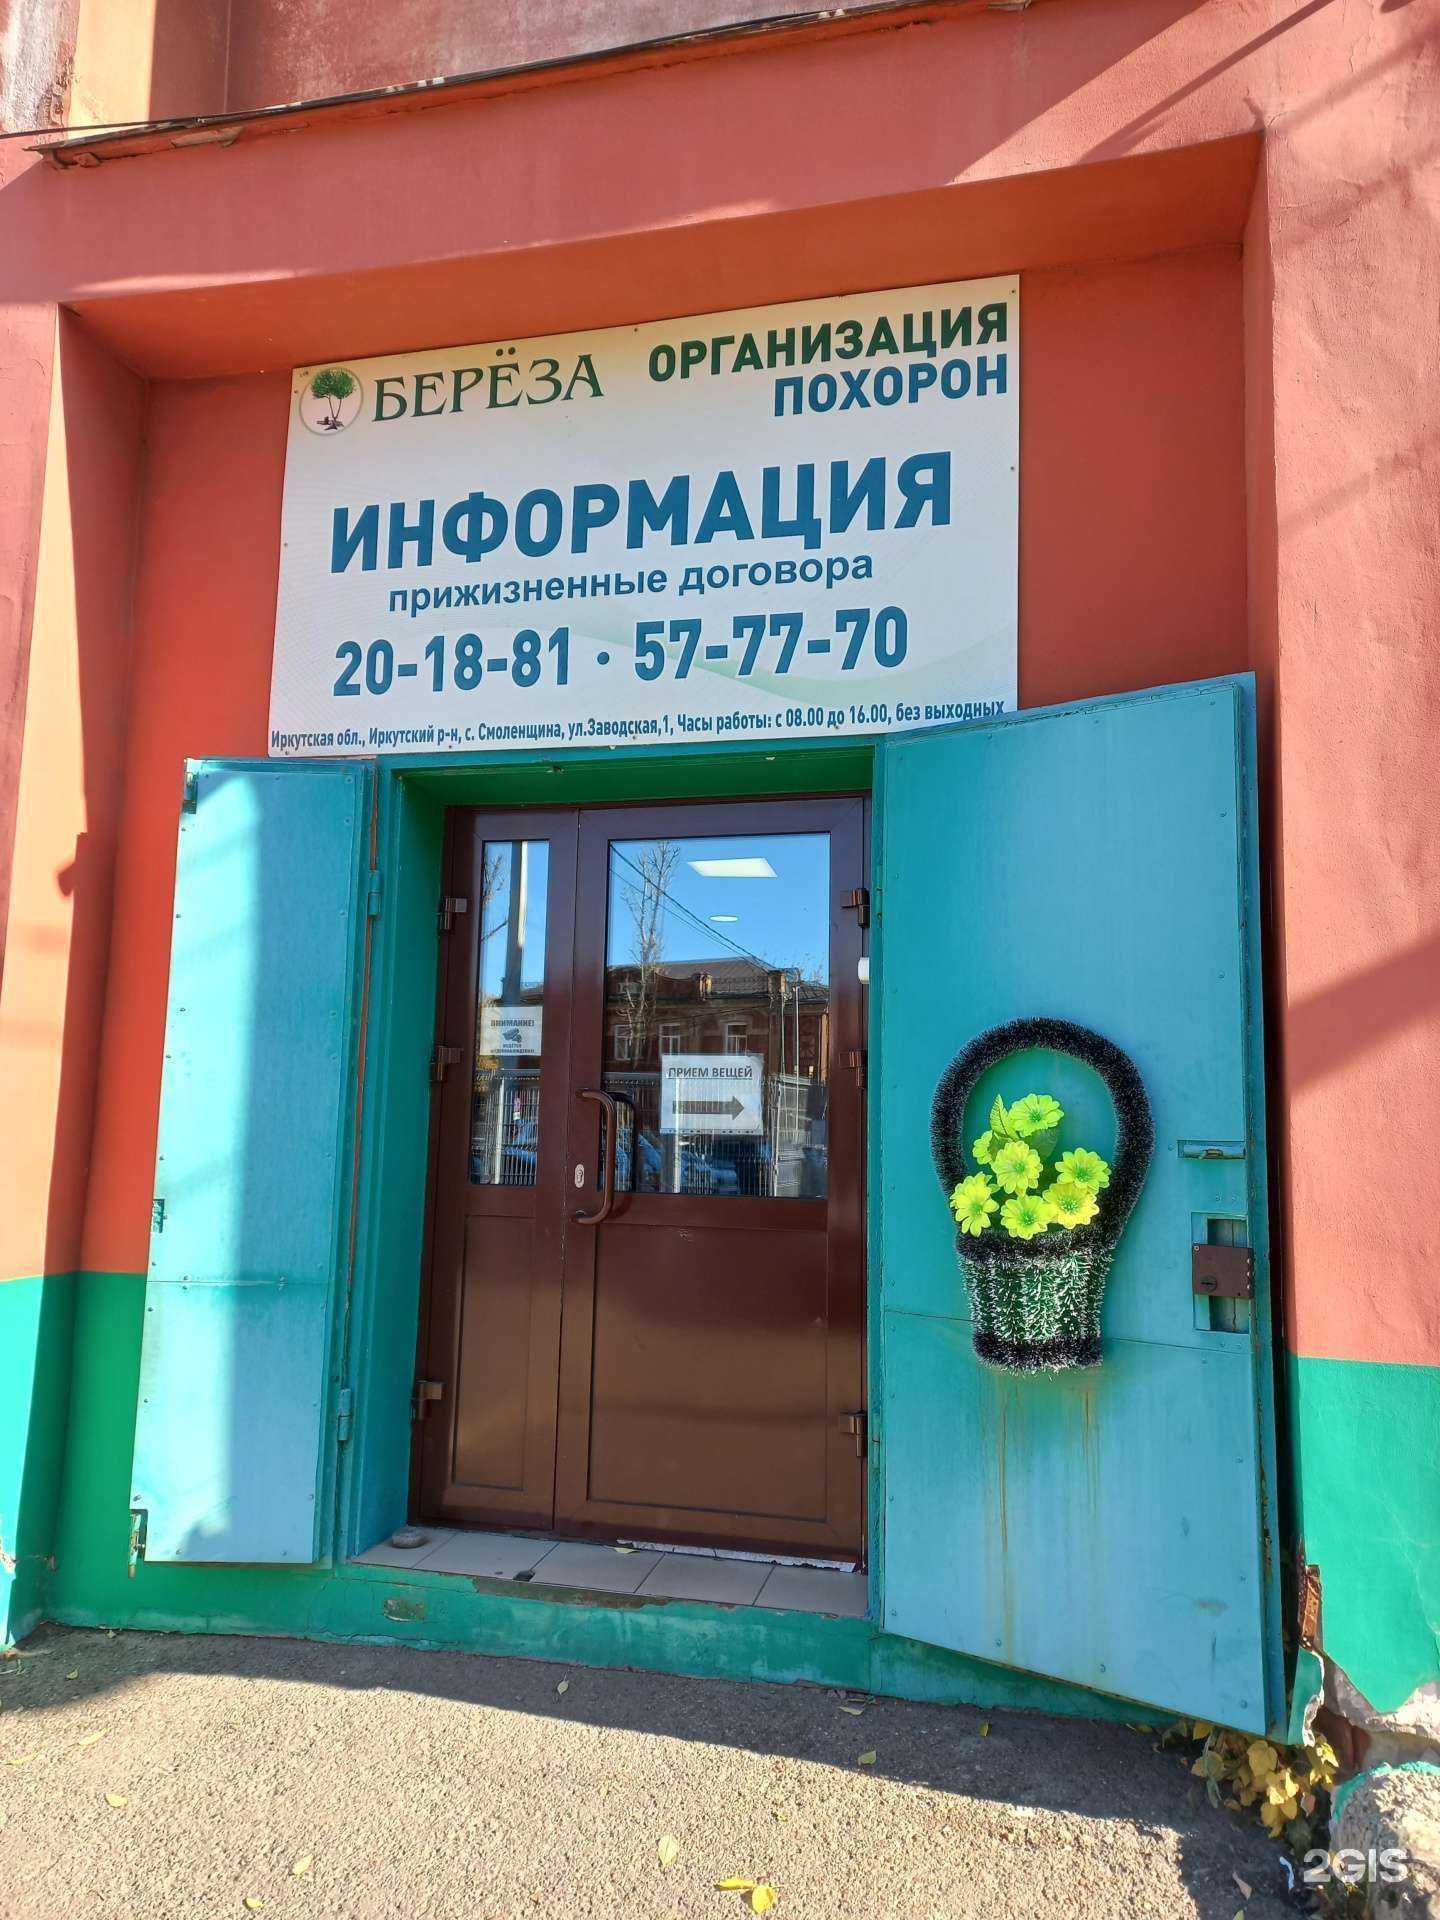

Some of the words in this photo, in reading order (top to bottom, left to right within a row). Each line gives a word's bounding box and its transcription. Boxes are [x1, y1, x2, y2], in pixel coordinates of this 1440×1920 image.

[649, 302, 1007, 382] ОРГАНИЗАЦИЯ
[372, 346, 605, 422] БЕРЁЗА
[774, 353, 1008, 417] ПОХОРОН
[331, 451, 951, 574] ИНФОРМАЦИЯ
[389, 569, 668, 618] прижизненные
[678, 554, 874, 596] договора
[333, 627, 570, 697] 20-18-81
[634, 606, 908, 682] 57-77-70
[271, 730, 334, 751] Иркутская
[337, 729, 366, 748] обл.,
[369, 725, 434, 748] Иркутский
[437, 728, 462, 746] р-н,
[478, 721, 565, 741] Смоленщина,
[677, 713, 713, 732] Часы
[716, 711, 772, 734] работы:
[775, 714, 782, 728] с
[786, 707, 823, 727] 08.00
[827, 710, 845, 728] до
[850, 703, 892, 725] 16.00,
[896, 702, 921, 721] без
[925, 700, 1005, 720] выходных
[668, 1067, 709, 1078] ПРИЕМ
[712, 1065, 753, 1078] ВЕЩЕЙ
